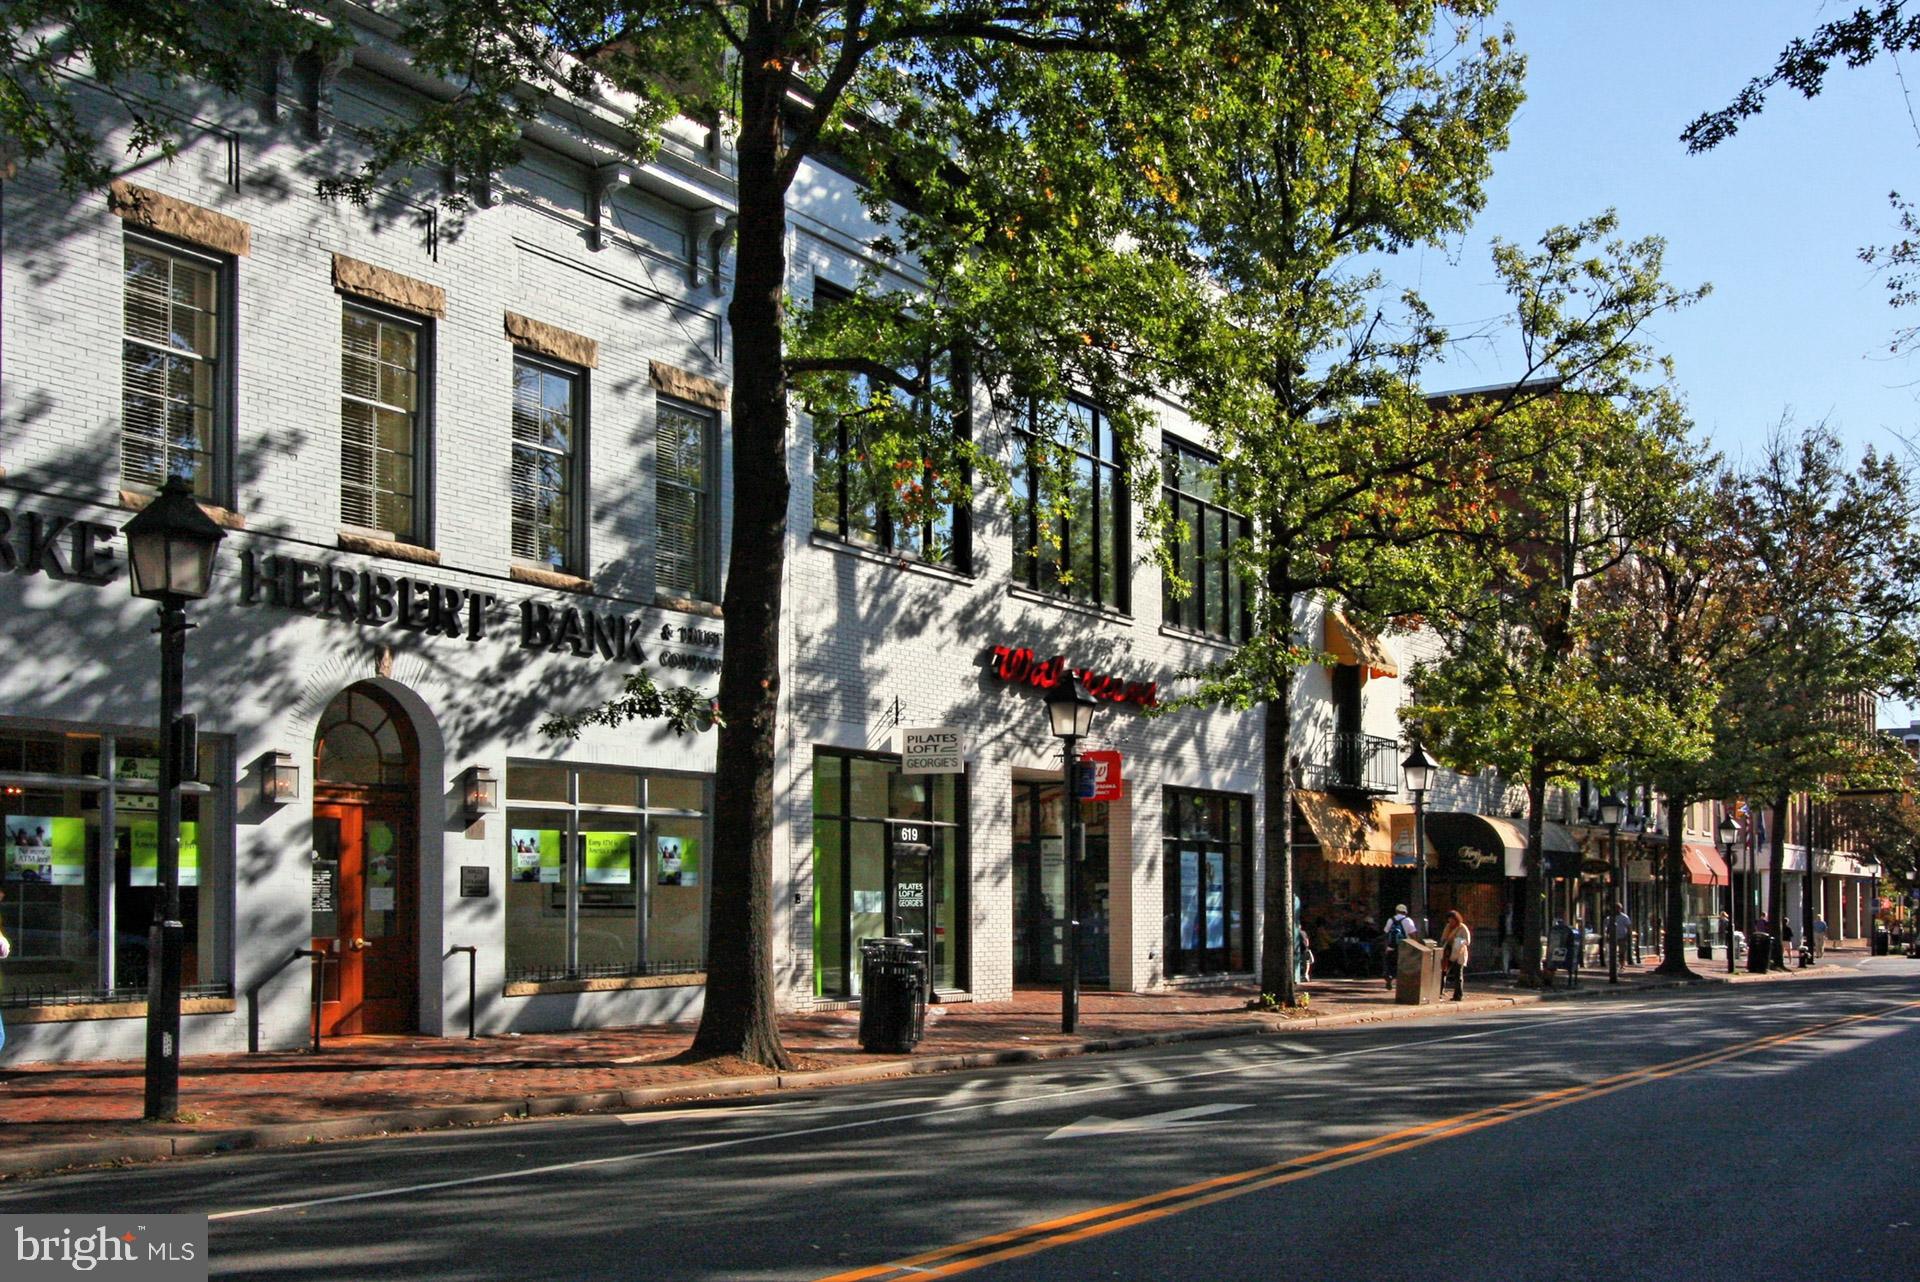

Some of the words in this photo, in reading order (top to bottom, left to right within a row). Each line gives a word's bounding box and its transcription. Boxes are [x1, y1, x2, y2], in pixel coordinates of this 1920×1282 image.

[237, 549, 497, 641] HERBERT
[519, 599, 648, 665] BANK
[661, 623, 673, 640] &
[907, 733, 957, 743] PILATES
[907, 744, 939, 754] LOFT
[906, 757, 959, 769] GEORGIE'S
[901, 827, 918, 841] 619
[898, 882, 923, 890] PILATES
[898, 890, 914, 898] LOFT
